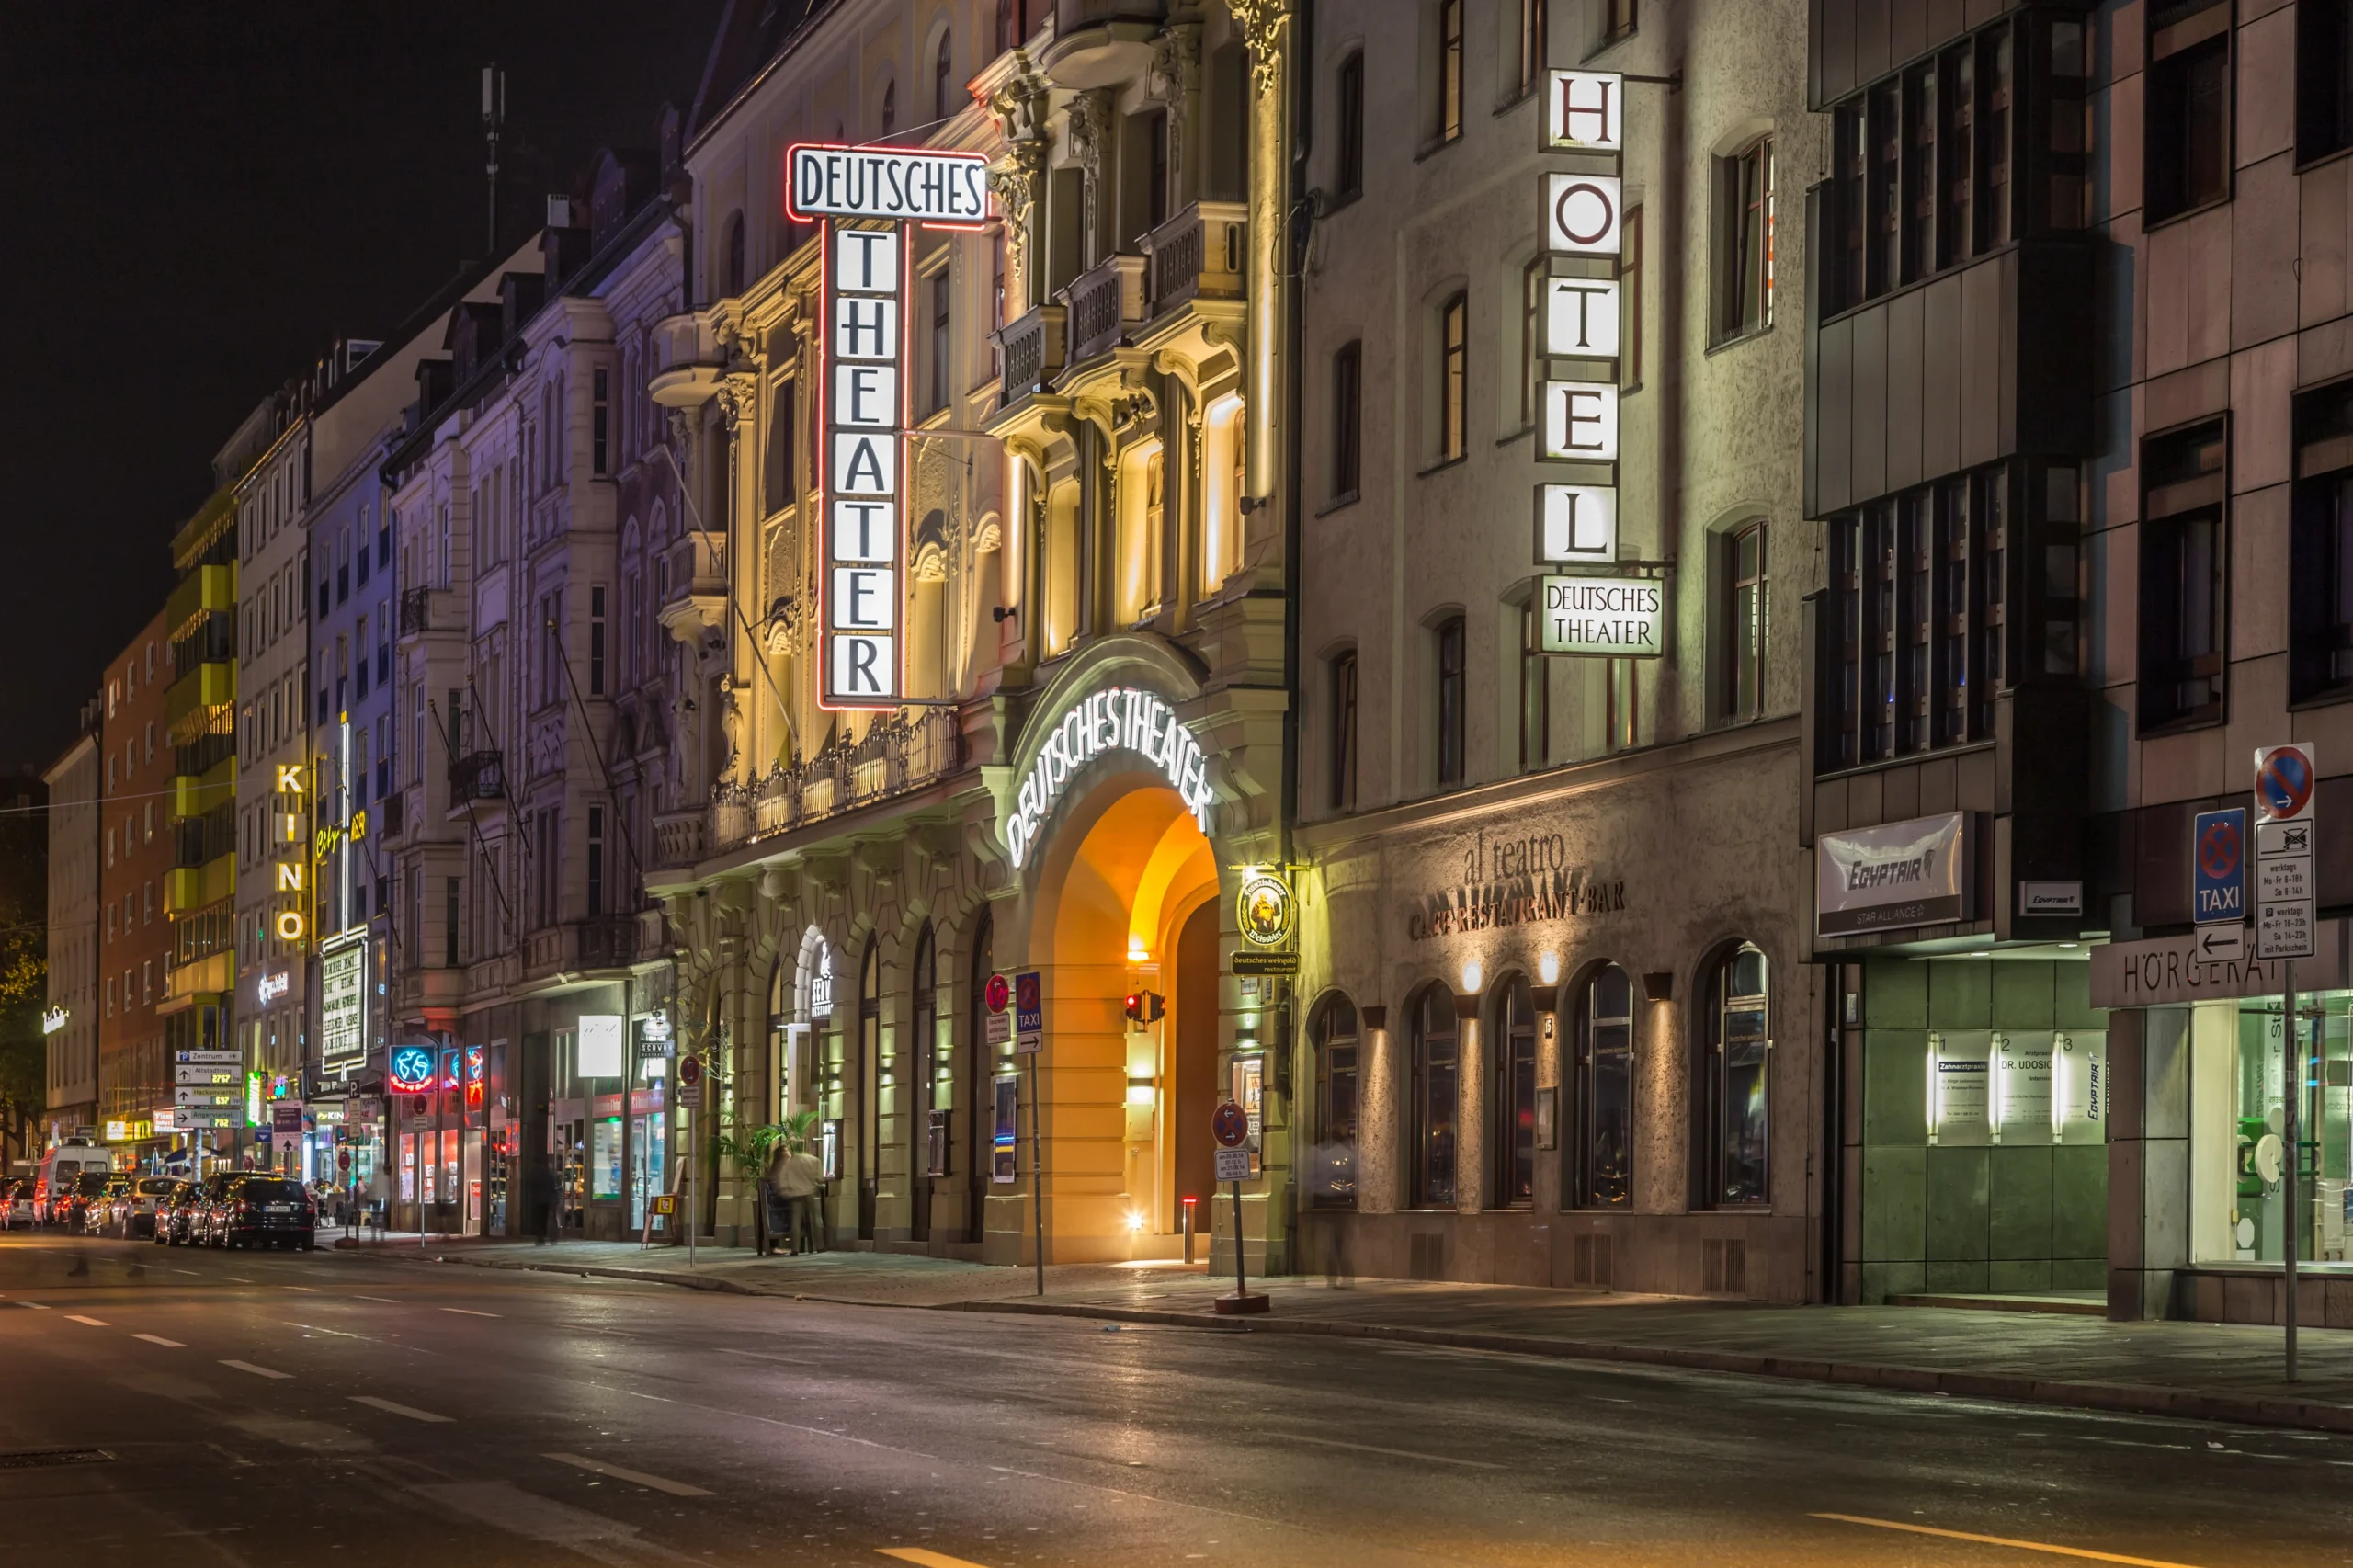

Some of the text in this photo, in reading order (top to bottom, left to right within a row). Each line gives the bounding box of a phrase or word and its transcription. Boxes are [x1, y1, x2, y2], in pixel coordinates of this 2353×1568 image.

[802, 153, 983, 216] DEUTSCHES
[1555, 78, 1612, 554] HOTEL
[841, 233, 887, 692] THEATER
[1546, 585, 1660, 613] DEUTSCHES
[1554, 619, 1654, 646] THEATER
[1006, 687, 1214, 869] DEUTSCHES THEATER
[316, 824, 340, 858] City
[277, 765, 303, 940] KINO
[1464, 831, 1565, 886] al teatro
[2270, 863, 2297, 872] werktags
[1847, 858, 1922, 892] EGYPTAIR
[2263, 875, 2303, 885] Mo-Fr 8-18h
[1244, 879, 1287, 897] Franziskaner
[2284, 887, 2303, 895] 8-14h
[1586, 880, 1626, 914] BAR
[2032, 895, 2069, 904] EGYPTAIR
[2199, 886, 2240, 912] TAXI
[1857, 905, 1916, 925] STAR ALLIANCE
[2277, 907, 2303, 916] werktags
[2263, 918, 2306, 929] Mo-Fr 18-23h
[1248, 929, 1283, 943] Weissbier
[2284, 931, 2306, 940] 14-23h
[2265, 942, 2308, 953] mit Parkschein
[1234, 956, 1297, 965] deutsches weingold
[1018, 1013, 1040, 1028] TAXI
[1545, 1019, 1552, 1033] 15
[1939, 1038, 1946, 1051] 1
[2001, 1038, 2010, 1051] 2
[2063, 1038, 2073, 1051] 3
[1939, 1062, 1985, 1071] Zahnarztpraxis
[2001, 1061, 2017, 1069] DR.
[2087, 1063, 2099, 1120] EGYPTAIR
[327, 1111, 344, 1120] KIN
